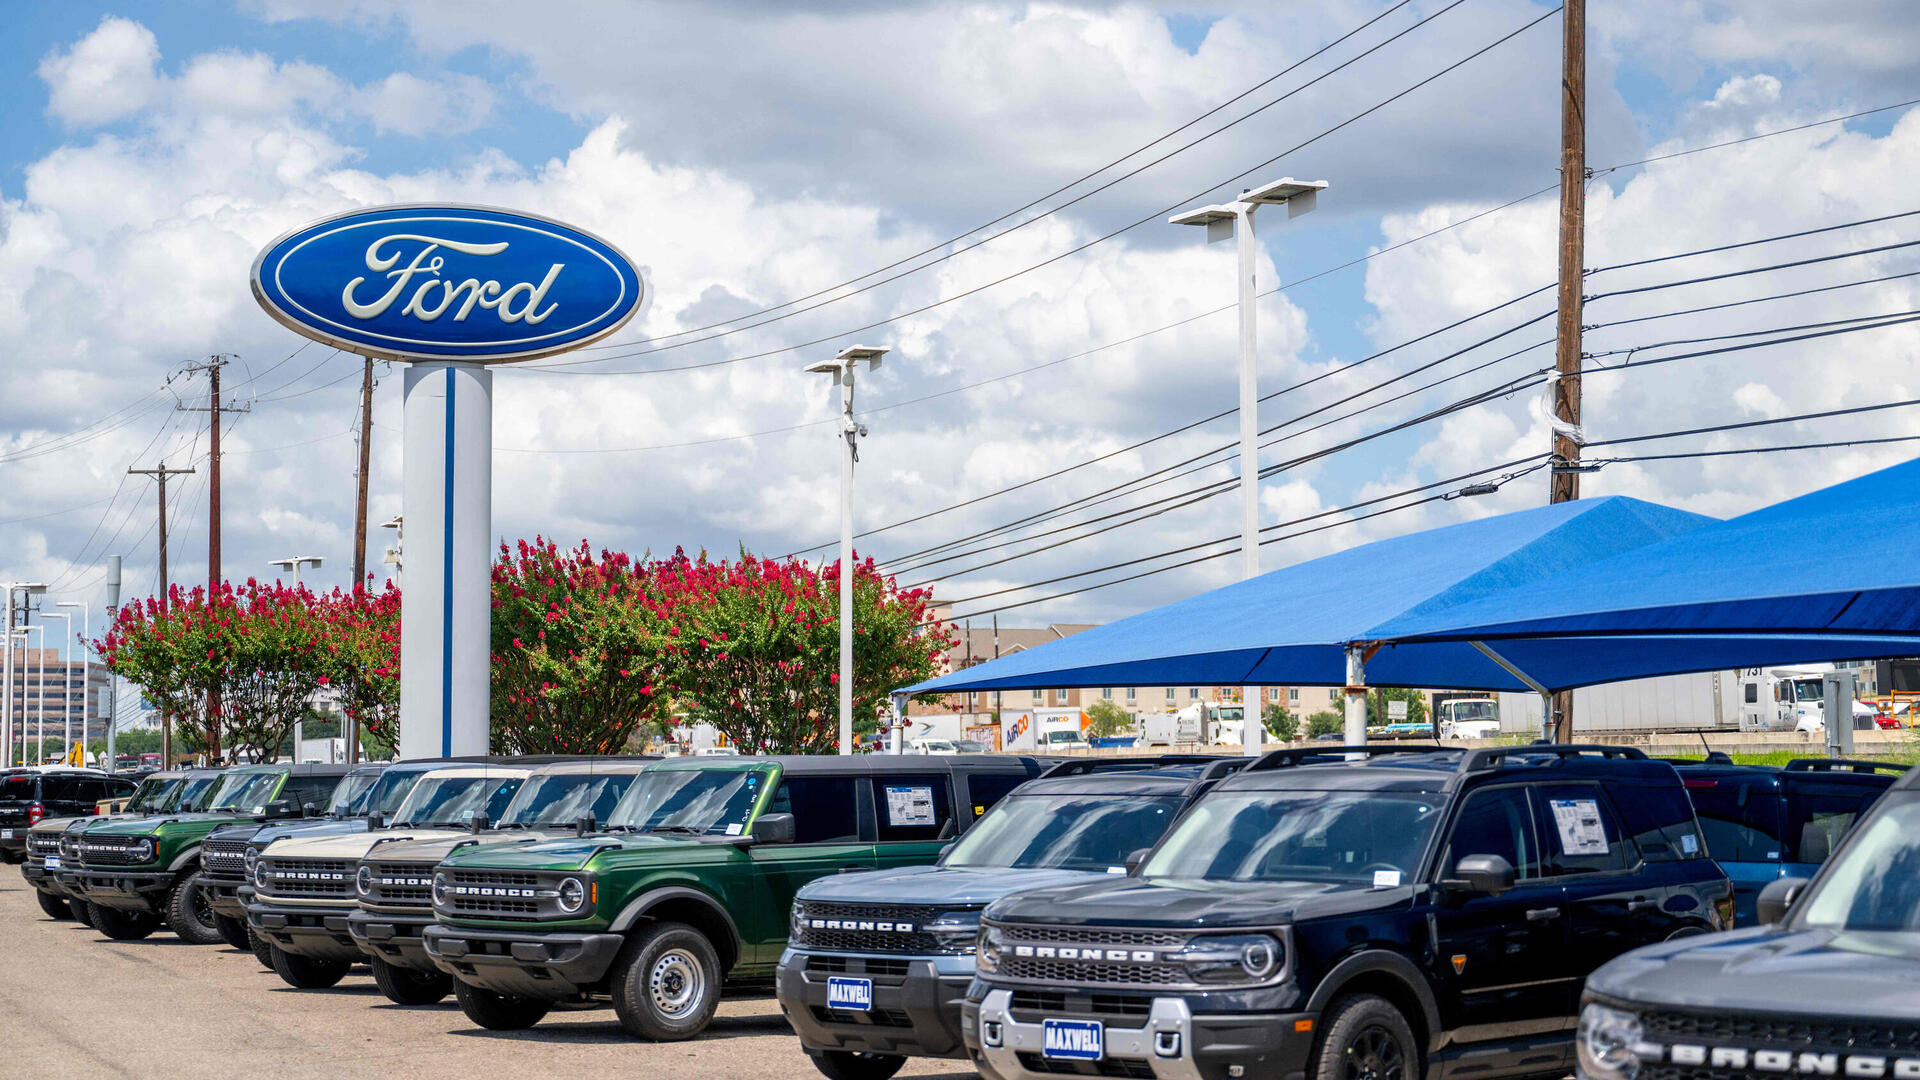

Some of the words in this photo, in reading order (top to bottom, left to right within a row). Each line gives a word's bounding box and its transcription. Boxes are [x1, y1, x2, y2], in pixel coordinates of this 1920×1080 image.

[342, 234, 566, 325] Ford
[276, 872, 343, 880] BRONCO
[455, 887, 535, 897] BRONCO
[812, 920, 913, 932] BRONCO
[1015, 946, 1155, 962] BRONCO
[829, 982, 870, 1004] MAXWELL
[1045, 1027, 1100, 1052] MAXWELL
